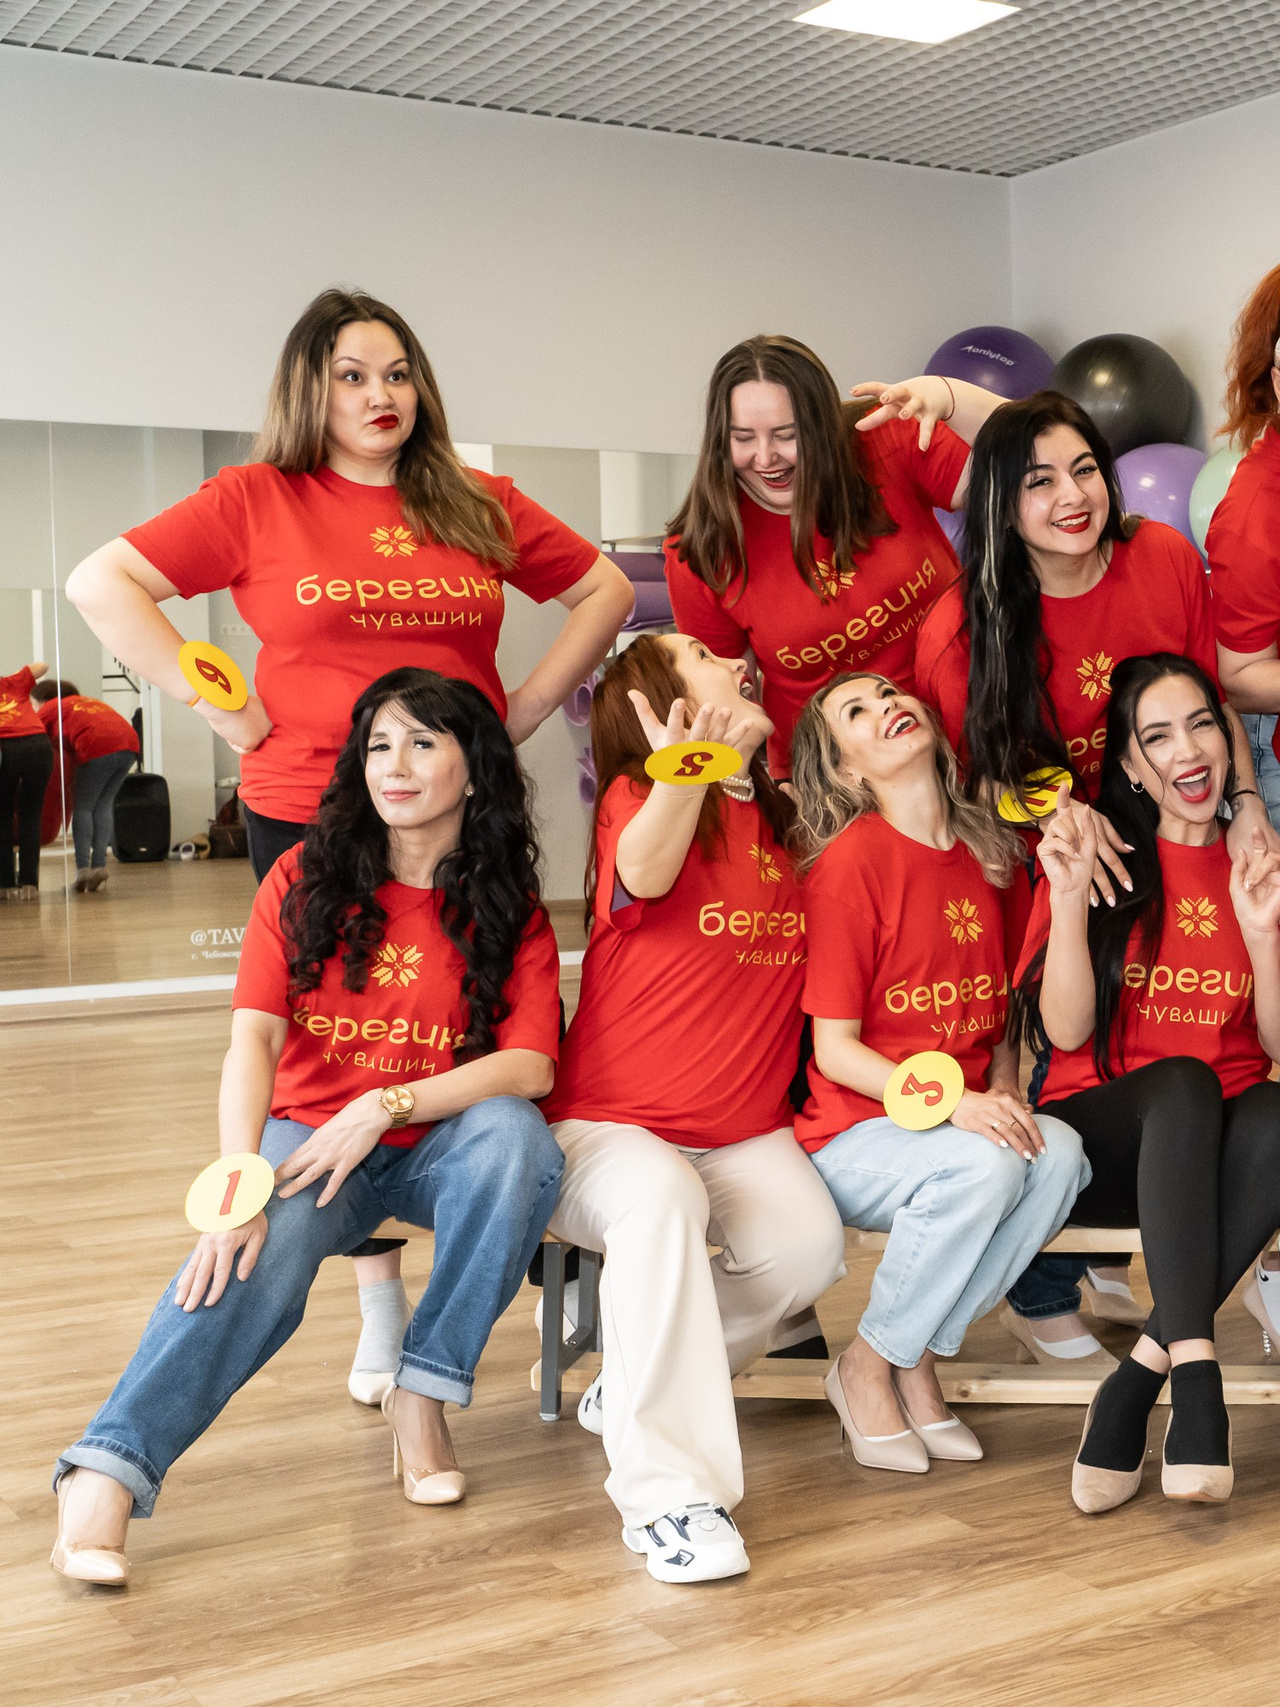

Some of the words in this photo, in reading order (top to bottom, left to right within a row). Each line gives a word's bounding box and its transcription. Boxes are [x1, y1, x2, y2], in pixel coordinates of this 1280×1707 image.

[295, 573, 502, 608] берегиня
[349, 611, 483, 631] чувашии
[774, 557, 937, 670] берегиня
[190, 927, 247, 947] @TAV
[698, 900, 806, 944] берег
[884, 971, 1008, 1016] береги
[1135, 1002, 1233, 1026] чуваши
[218, 1170, 241, 1216] 1
